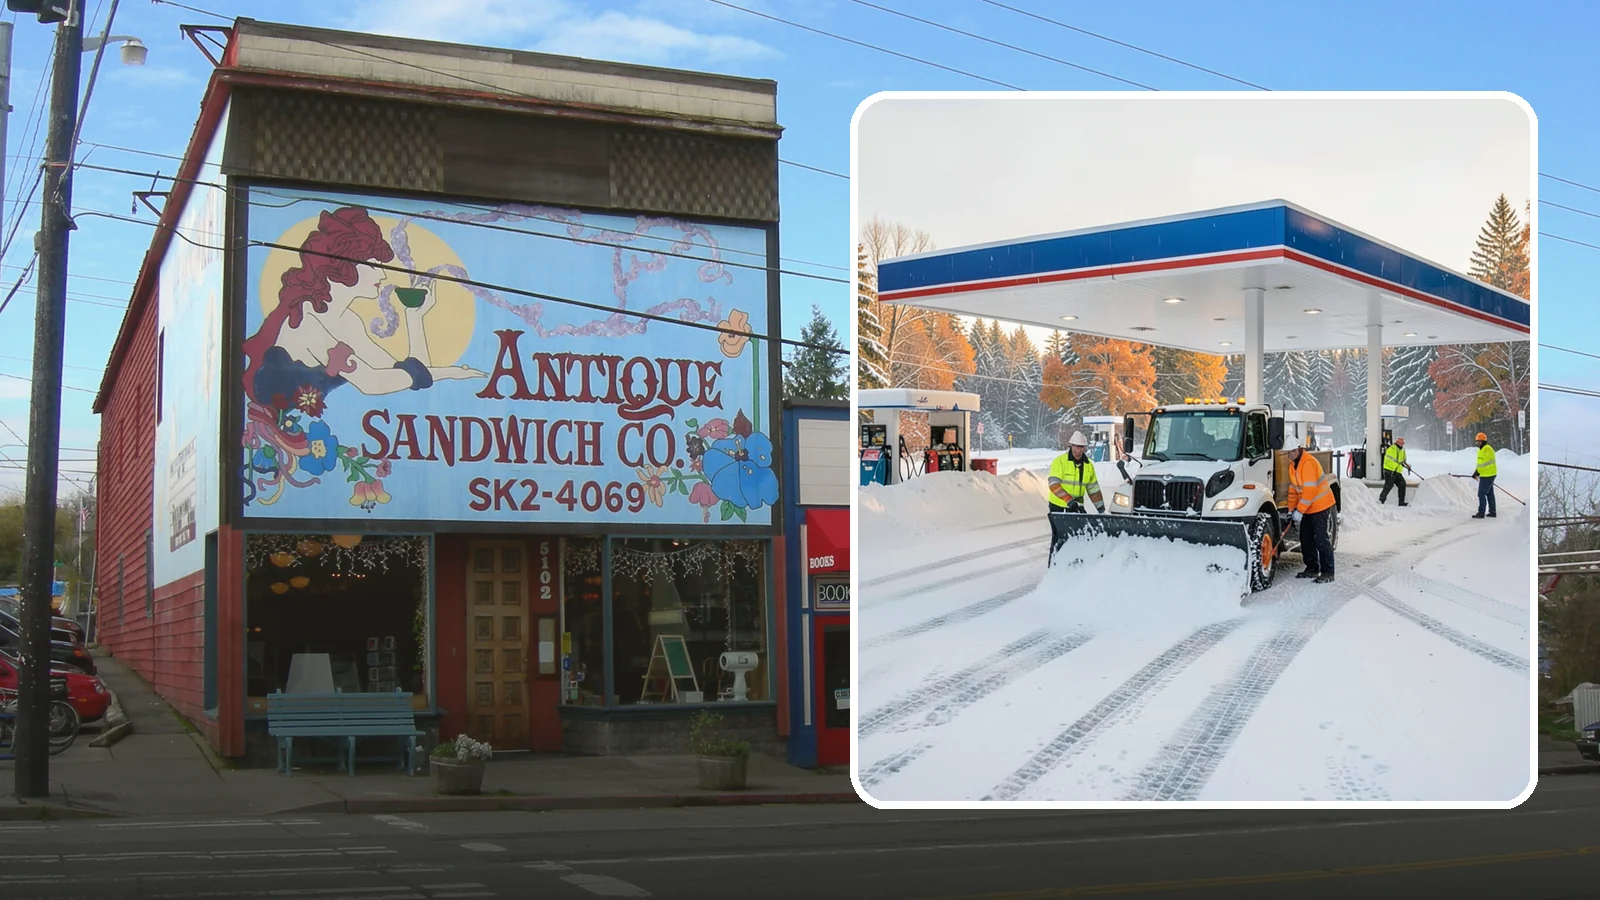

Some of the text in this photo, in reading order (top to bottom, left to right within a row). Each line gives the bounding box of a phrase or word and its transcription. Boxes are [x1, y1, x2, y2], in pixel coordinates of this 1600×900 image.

[476, 328, 723, 421] ANTIQUE
[361, 408, 685, 469] SANDWICH CO.
[468, 477, 646, 513] SK2-4069
[540, 543, 551, 599] 5102
[809, 555, 834, 568] BOOKS
